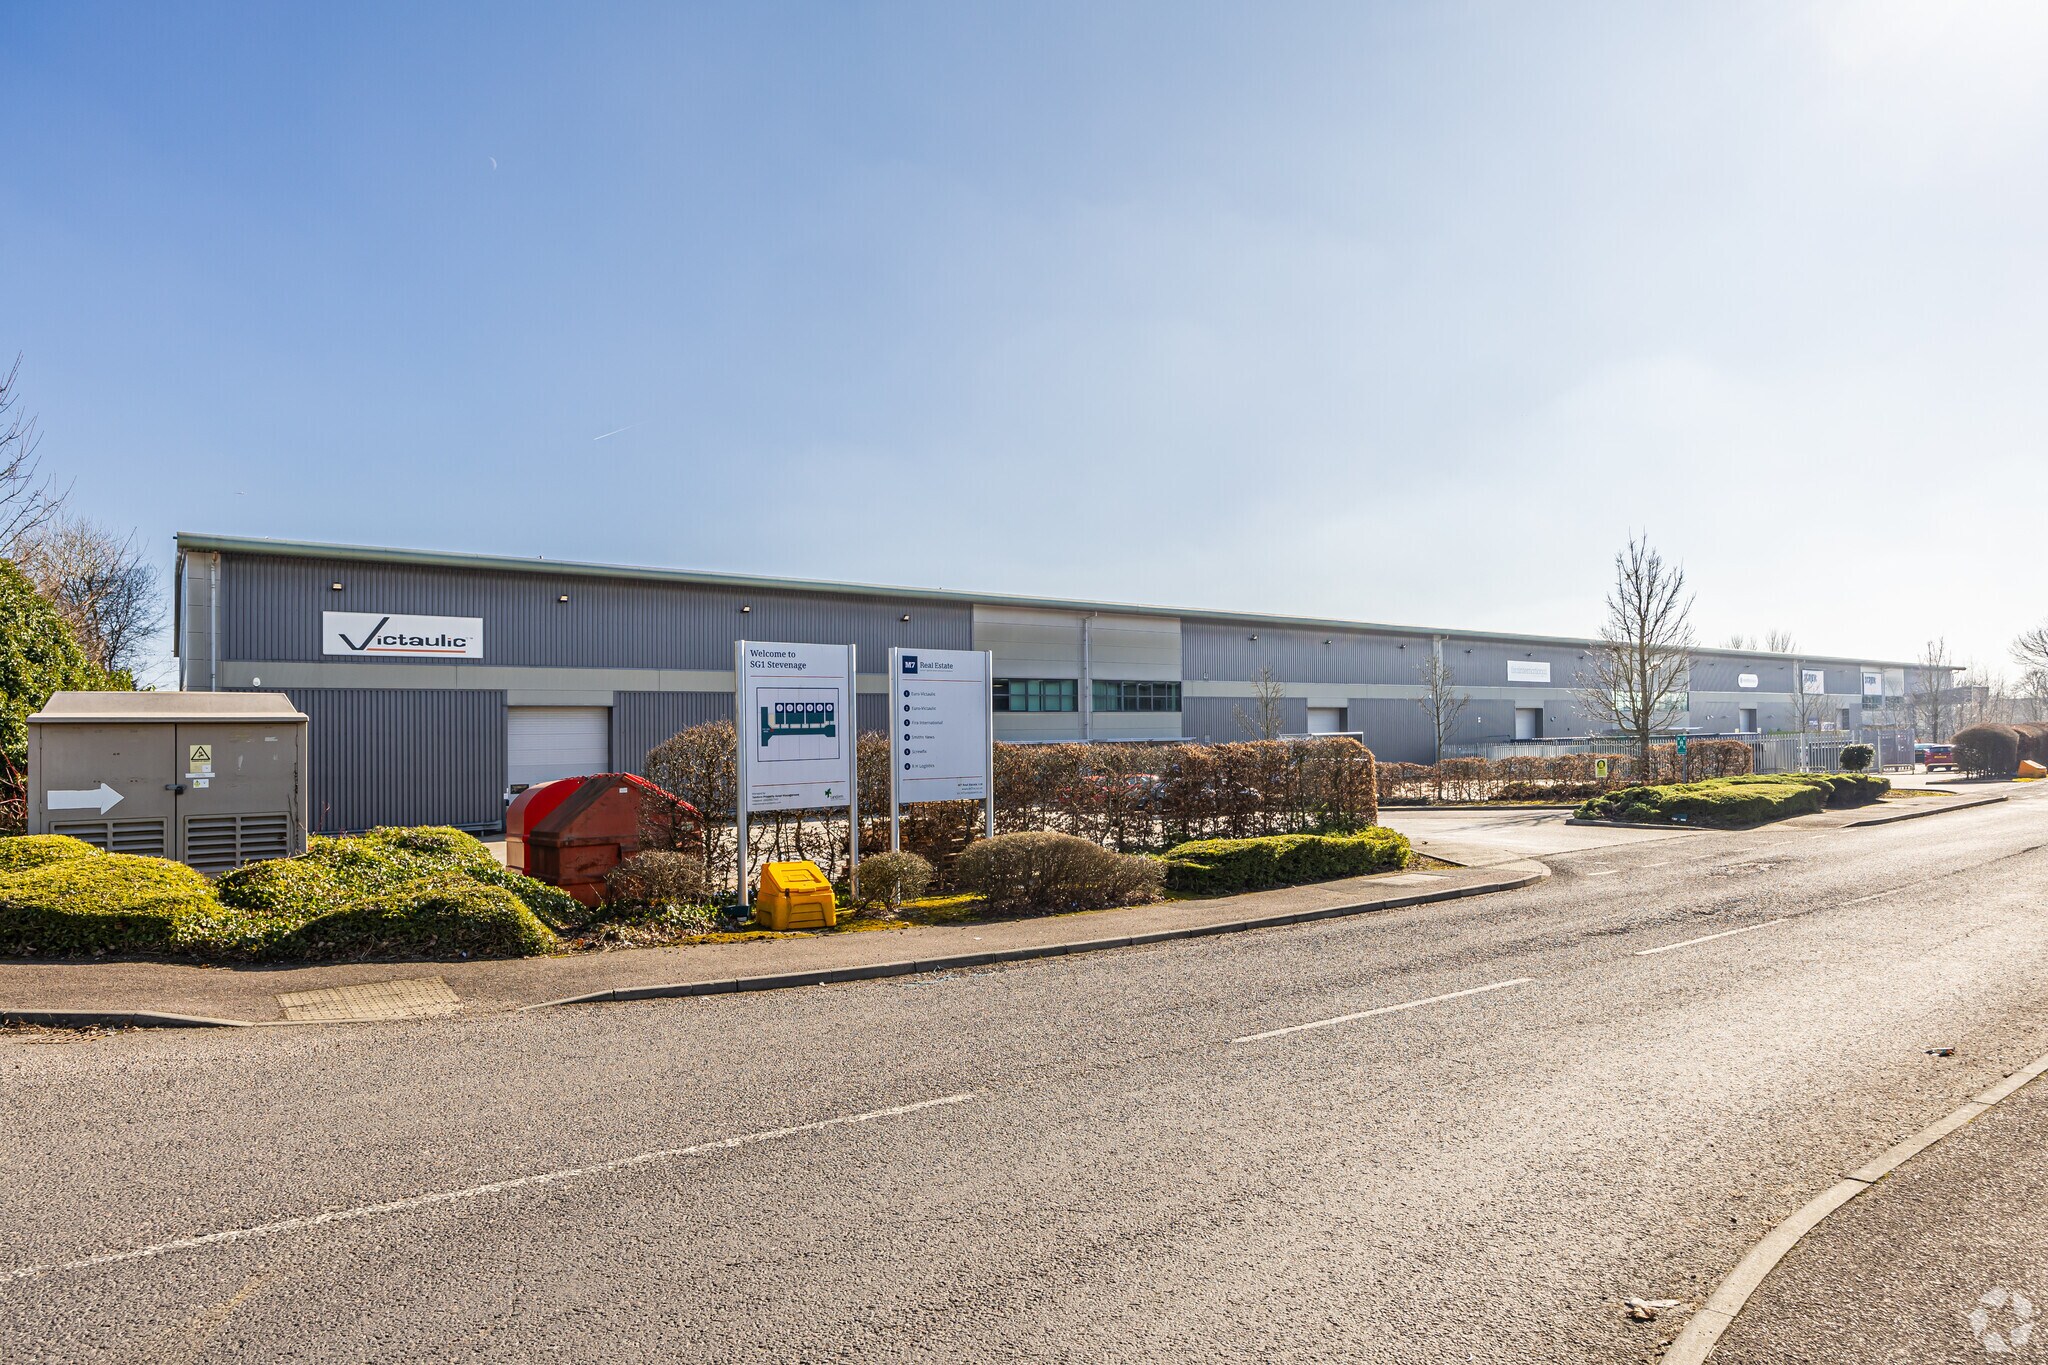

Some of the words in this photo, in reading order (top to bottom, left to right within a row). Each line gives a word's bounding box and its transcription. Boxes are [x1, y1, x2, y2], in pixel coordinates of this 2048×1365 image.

[338, 616, 467, 651] Victaulic
[750, 649, 787, 658] Welcome
[788, 651, 796, 659] to
[750, 660, 766, 669] SG1
[767, 660, 807, 671] Stevenage
[904, 661, 916, 669] M7
[934, 662, 954, 670] Estate
